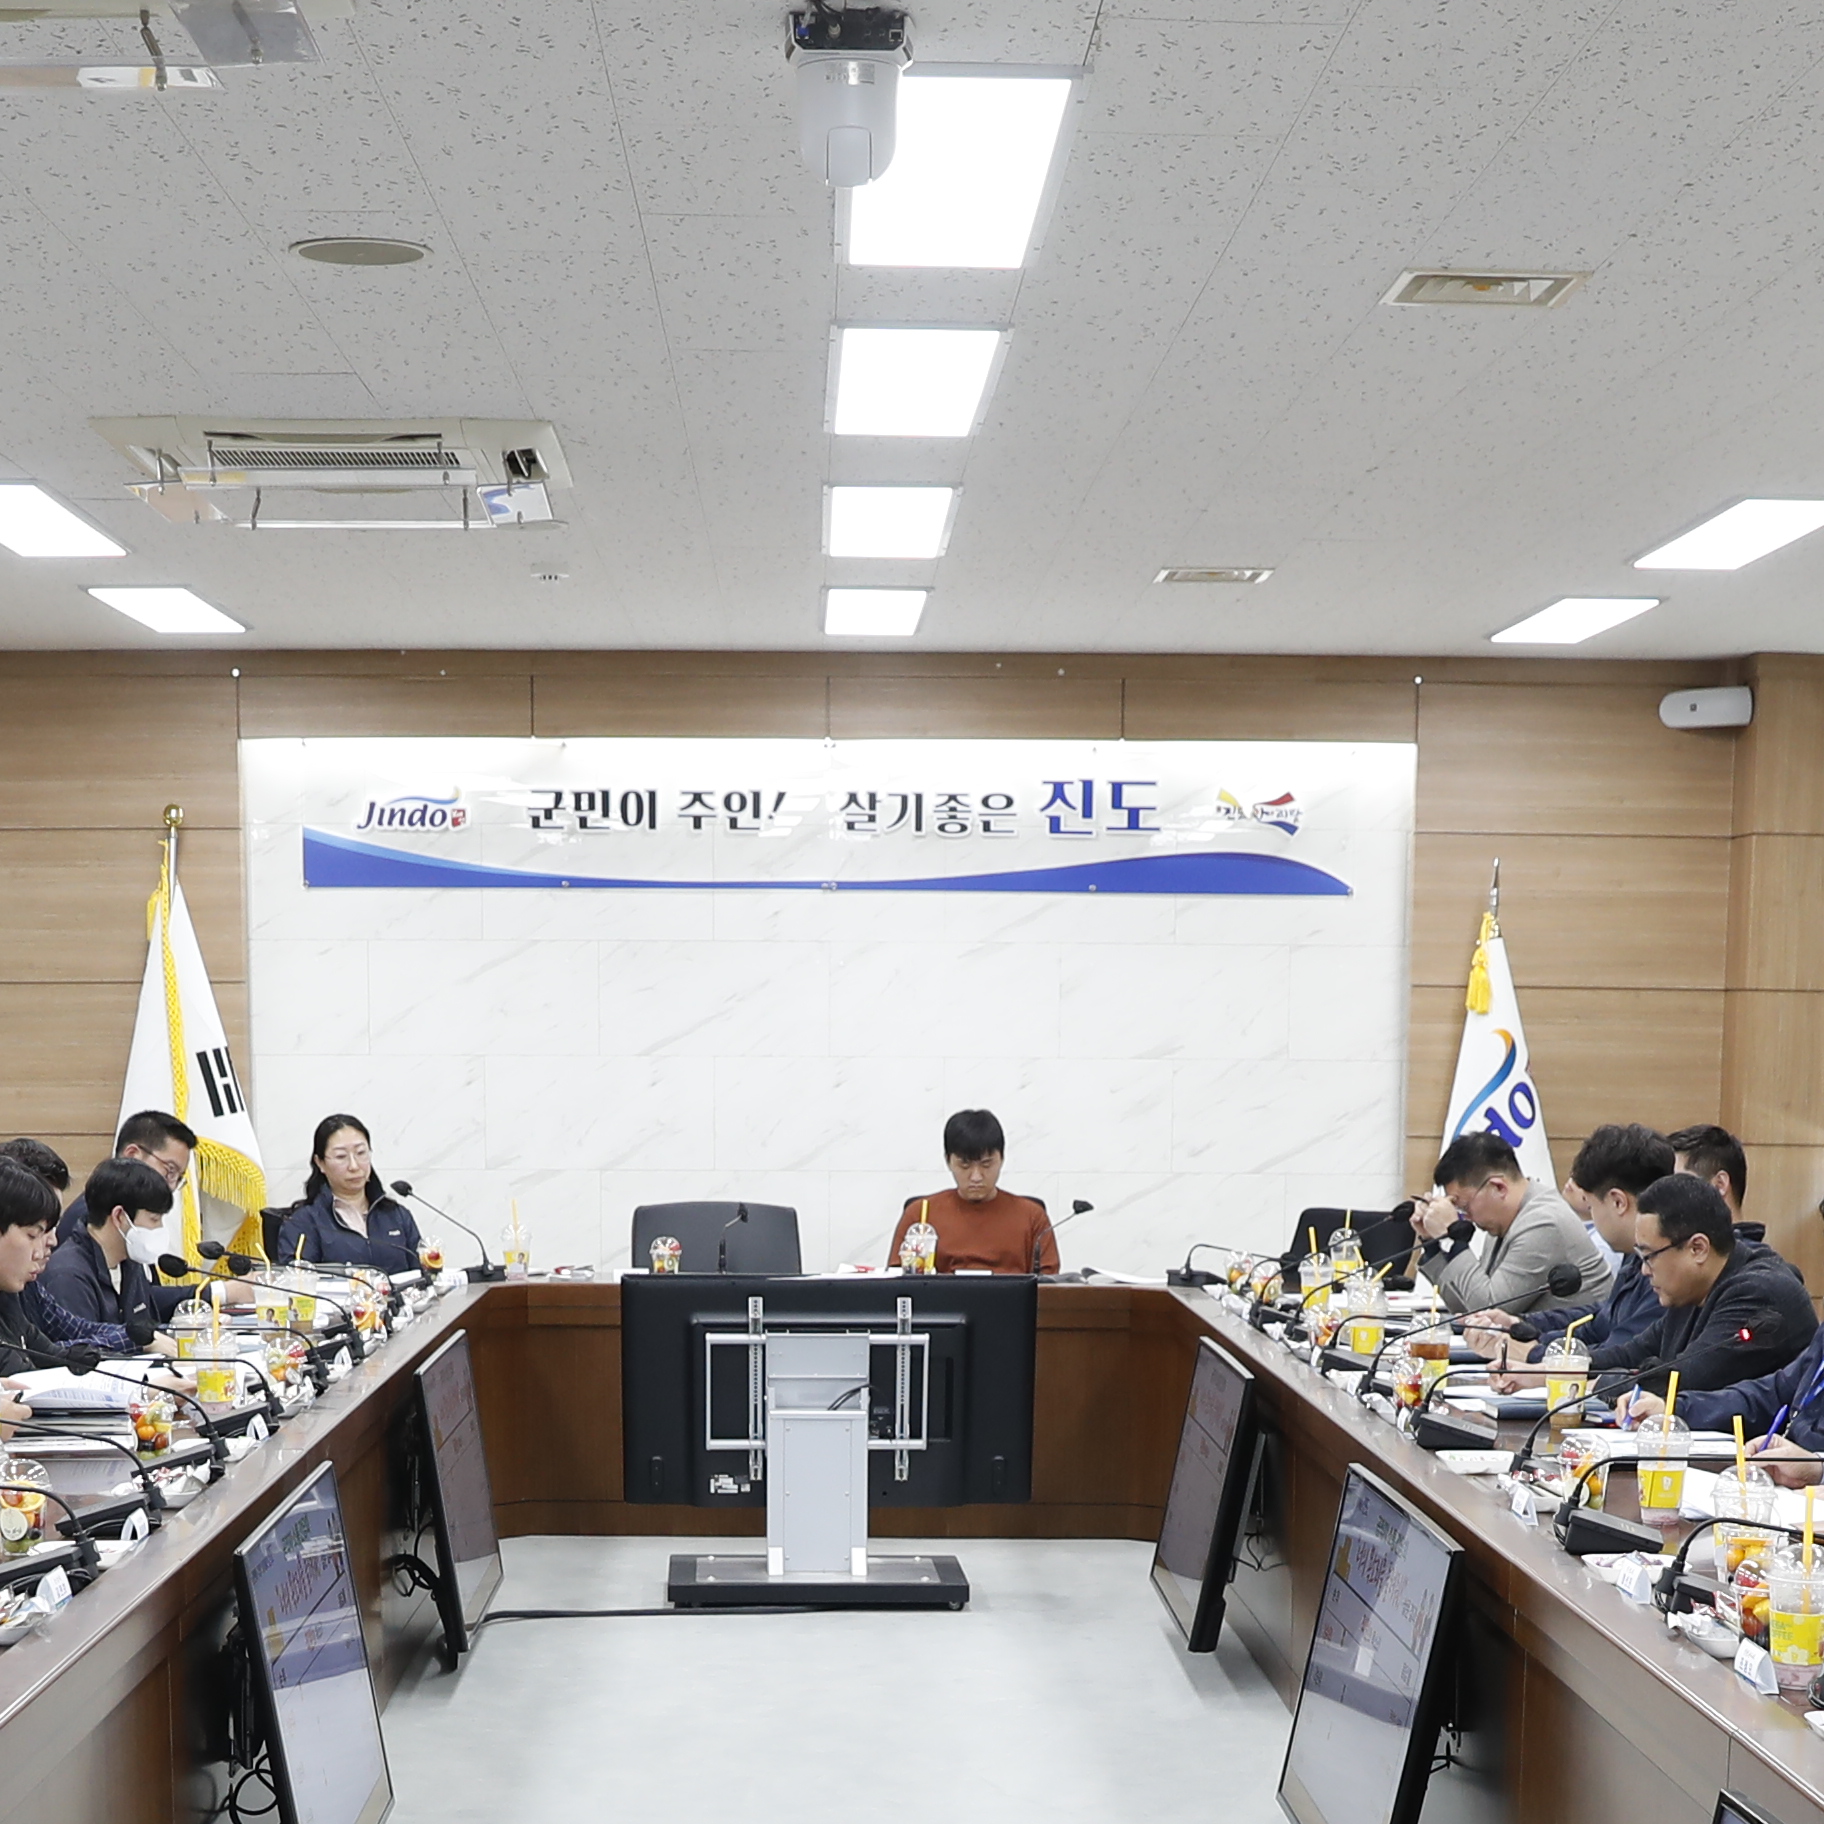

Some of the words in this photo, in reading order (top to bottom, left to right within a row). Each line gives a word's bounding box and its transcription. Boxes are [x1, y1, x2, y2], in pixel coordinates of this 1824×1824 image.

[356, 800, 448, 830] Jindo
[527, 789, 658, 831] 군민이
[678, 789, 788, 831] 주인!
[839, 791, 1018, 834] 살기좋은
[1039, 779, 1163, 835] 진도
